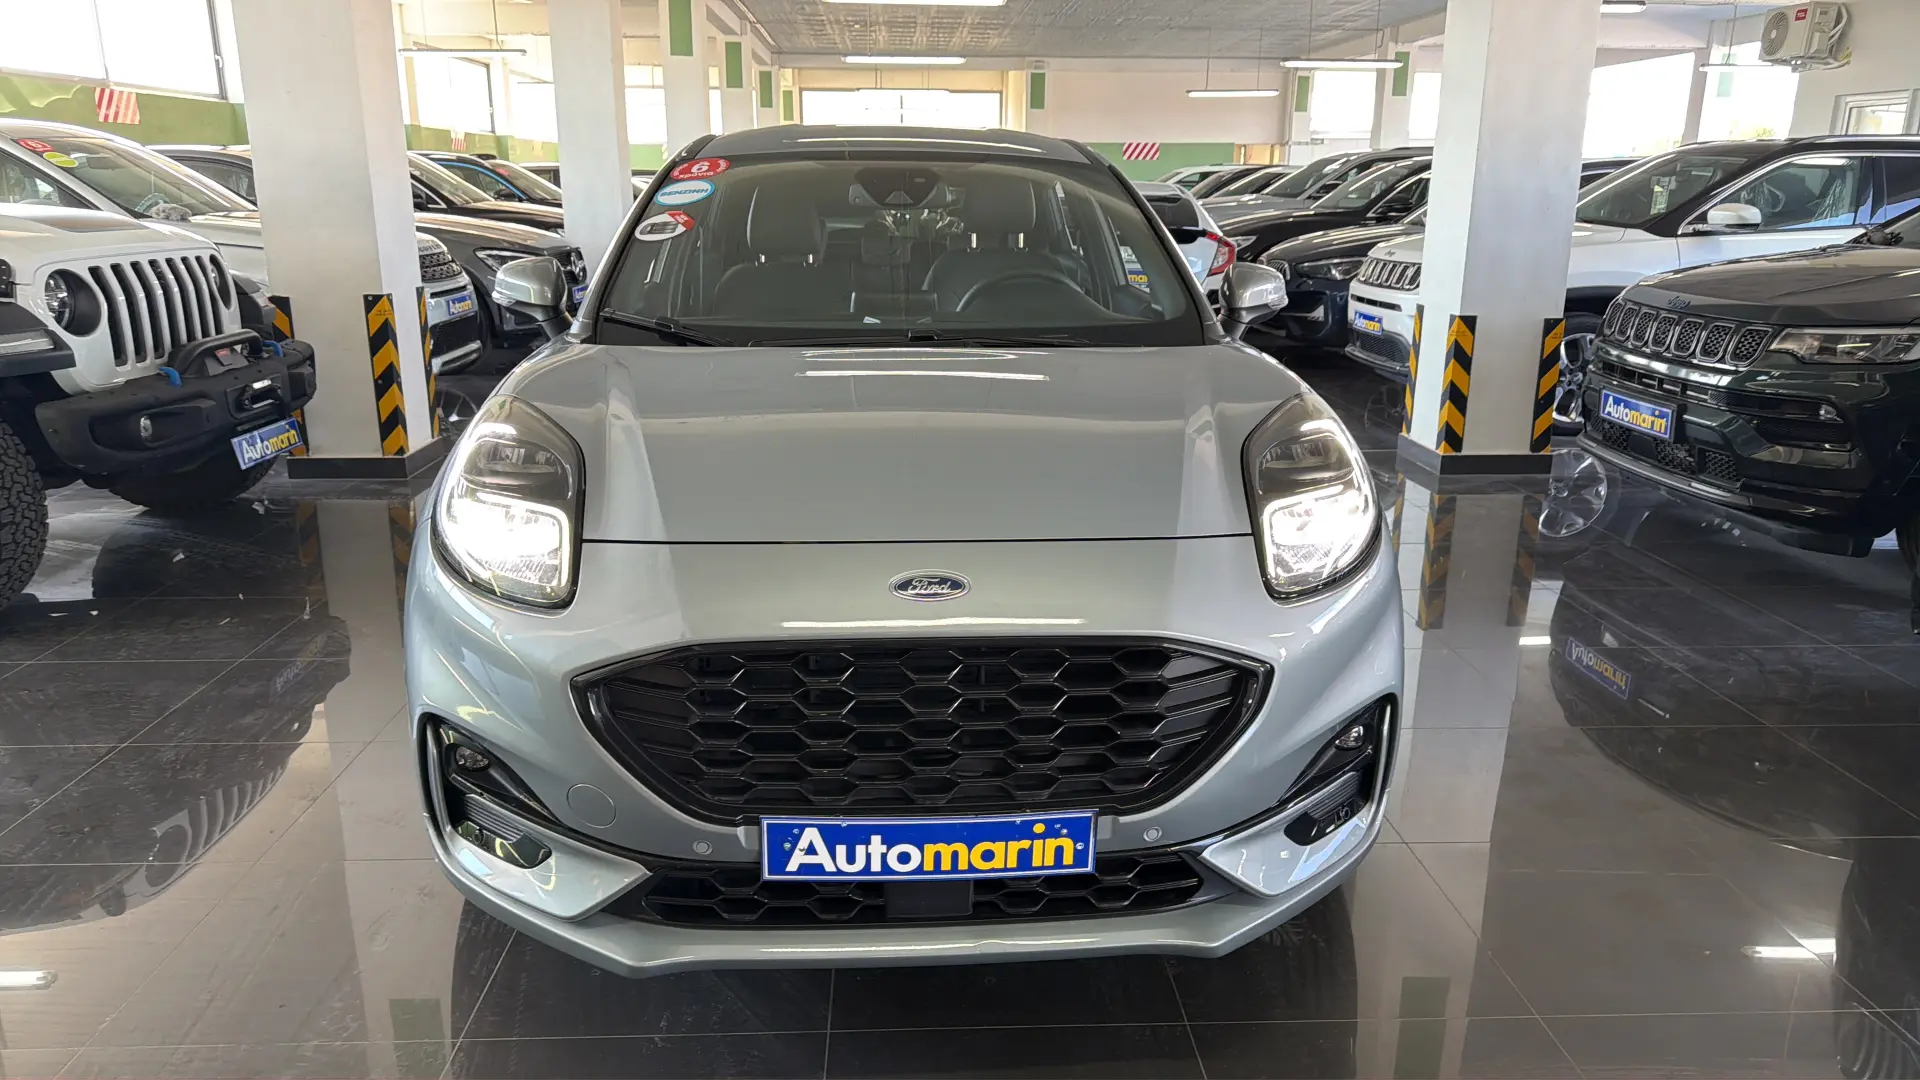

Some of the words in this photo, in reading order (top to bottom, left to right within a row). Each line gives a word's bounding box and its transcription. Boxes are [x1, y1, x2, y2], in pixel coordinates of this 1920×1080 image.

[691, 161, 710, 173] 6
[1604, 395, 1667, 433] Automarin
[242, 424, 299, 464] Automarin
[907, 578, 951, 594] Ford
[785, 823, 1074, 872] Automarin
